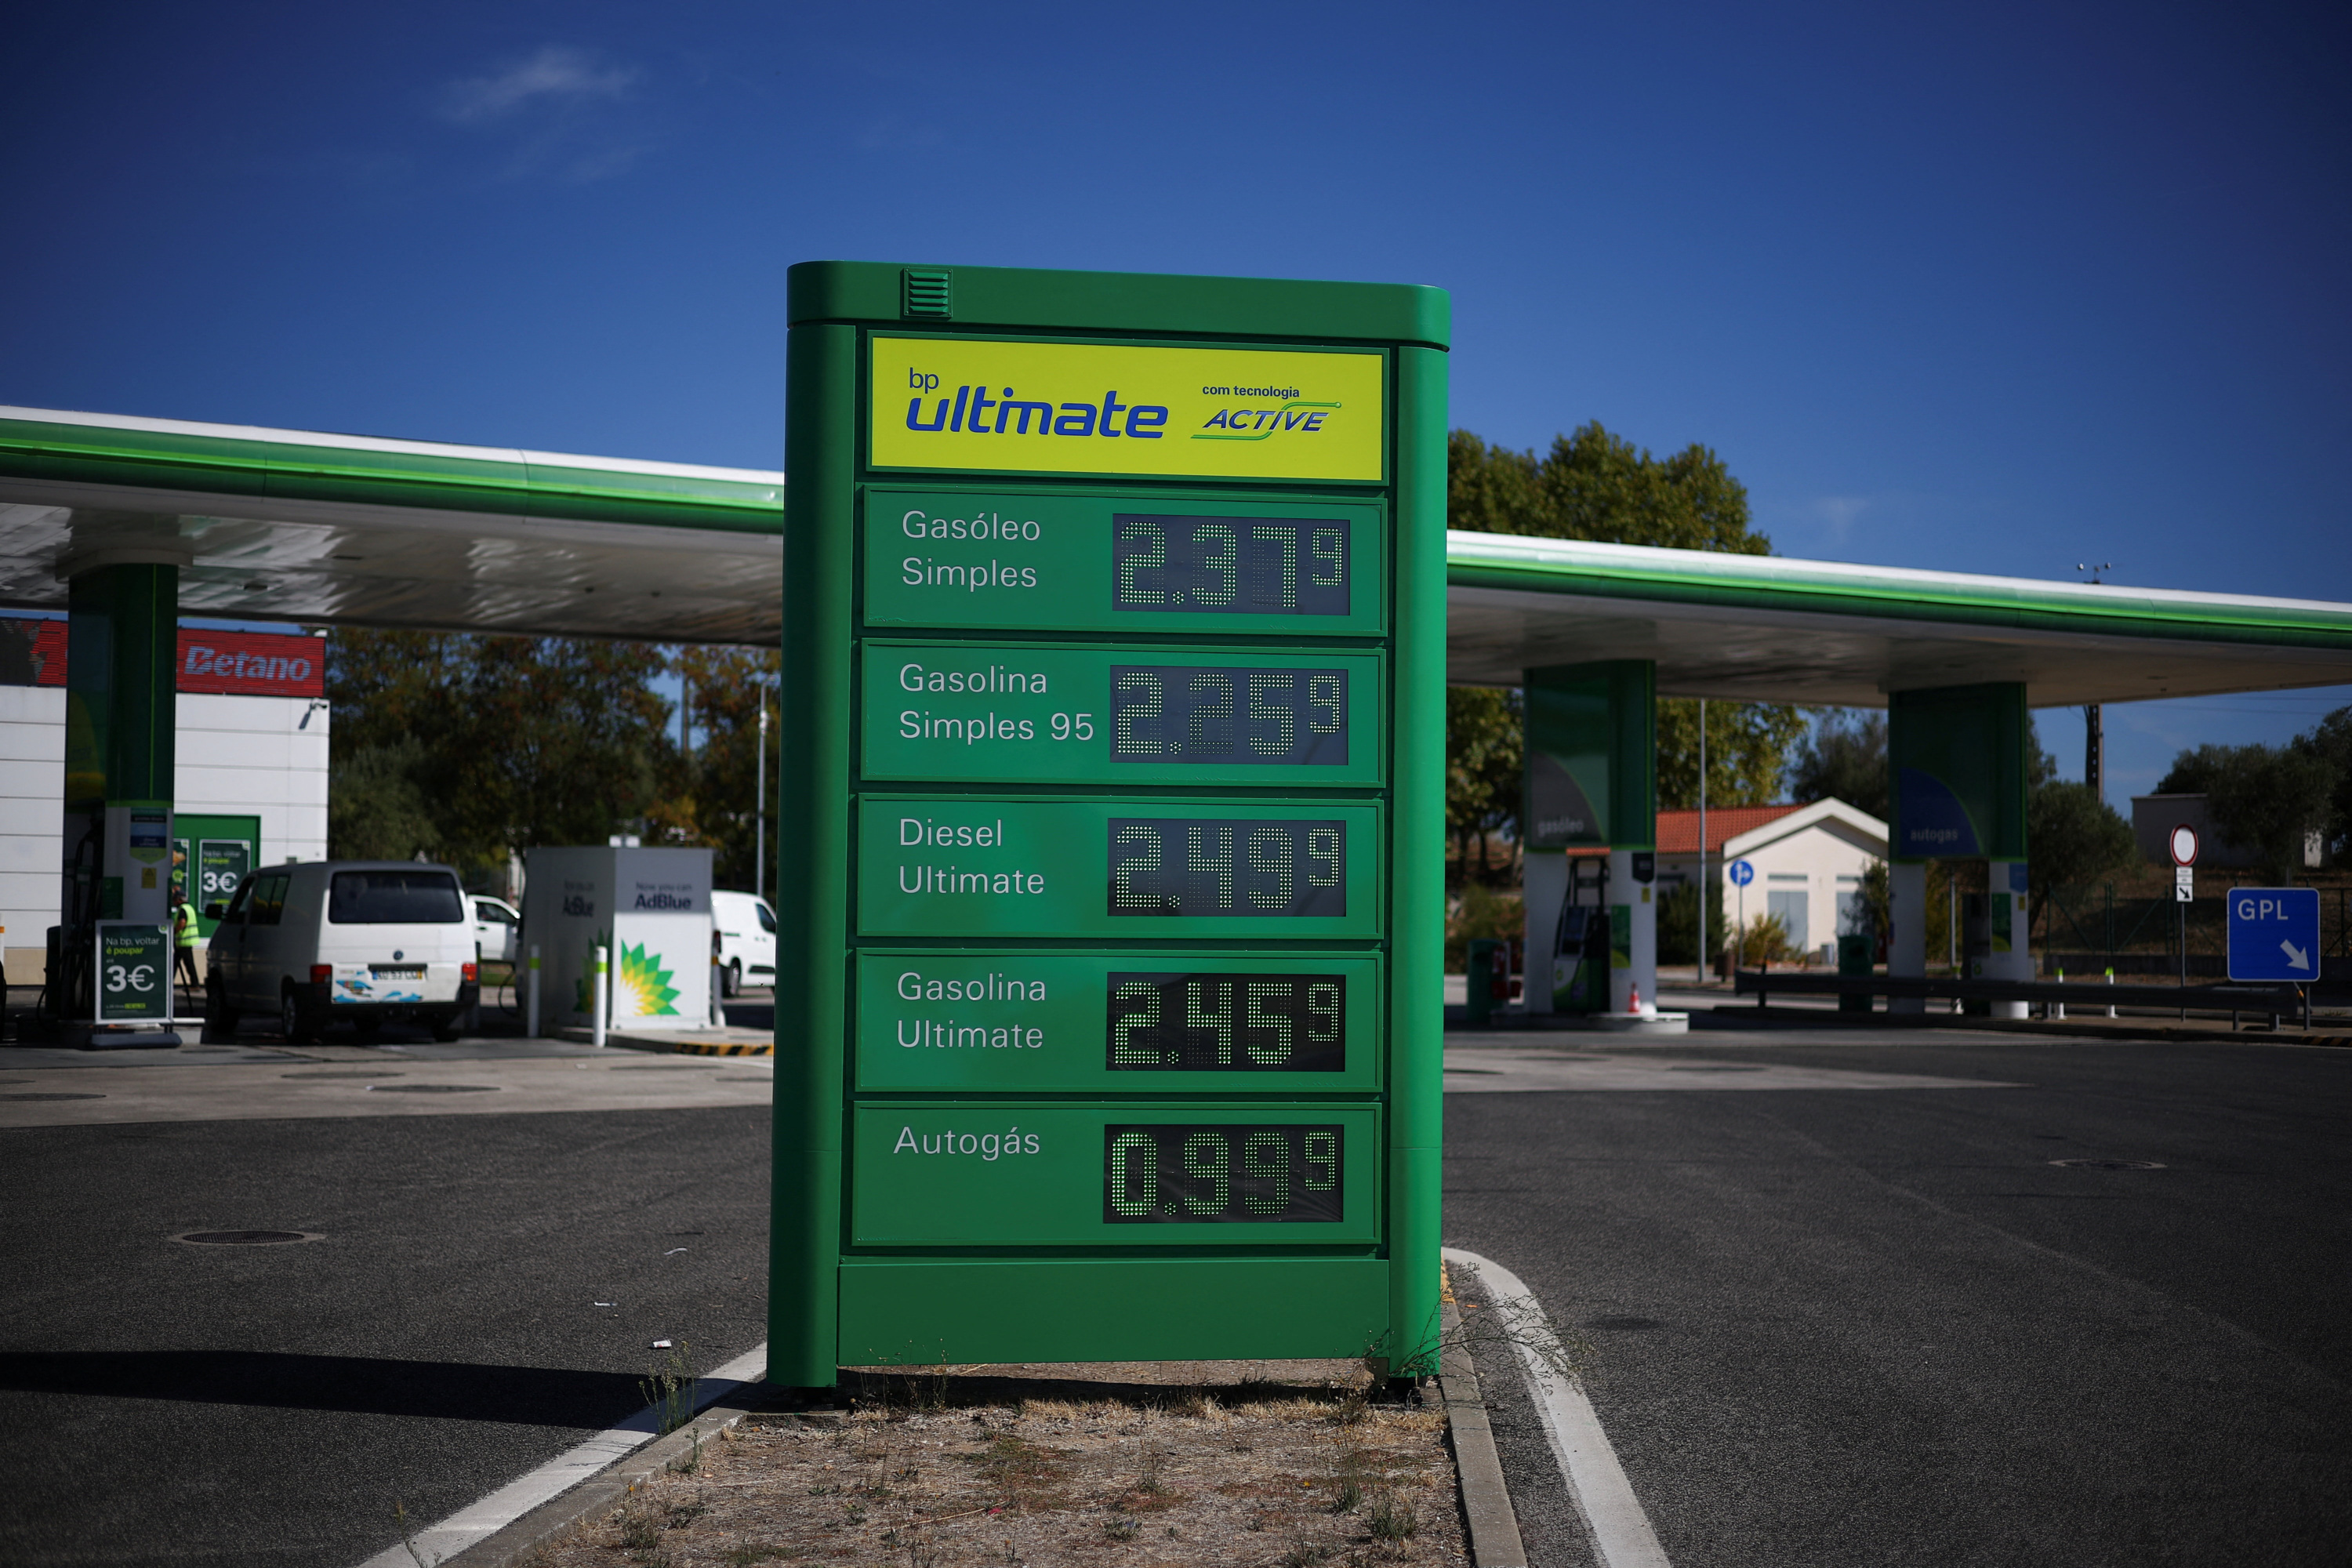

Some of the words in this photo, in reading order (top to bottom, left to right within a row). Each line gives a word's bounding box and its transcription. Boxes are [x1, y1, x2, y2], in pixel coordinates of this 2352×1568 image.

[909, 367, 939, 394] bp
[1202, 386, 1230, 395] com
[1233, 385, 1300, 400] tecnologia
[906, 386, 1168, 438] ultimate
[1202, 408, 1330, 432] ACTIVE
[902, 510, 1040, 541] Gasóleo
[902, 557, 1036, 593] Simples
[1120, 521, 1343, 608] 2.379
[184, 646, 311, 681] Betano
[900, 663, 1047, 694] Gasolina
[899, 711, 1034, 746] Simples
[1051, 712, 1094, 741] 95
[1117, 672, 1341, 756] 2.259
[900, 818, 1001, 847] Diesel
[203, 871, 238, 893] 3€
[899, 866, 1044, 895] Ultimate
[1116, 826, 1340, 909] 2.499
[634, 893, 692, 909] AdBlue
[2238, 898, 2288, 920] GPL
[106, 937, 118, 946] Na
[136, 937, 160, 946] voltar
[114, 947, 144, 956] poupar
[106, 964, 155, 993] 3€
[898, 971, 1045, 1001] Gasolina
[898, 1019, 1043, 1048] Ultimate
[1114, 982, 1339, 1065] 2.459
[893, 1126, 1040, 1161] Autogás
[1112, 1131, 1336, 1217] 0.999
